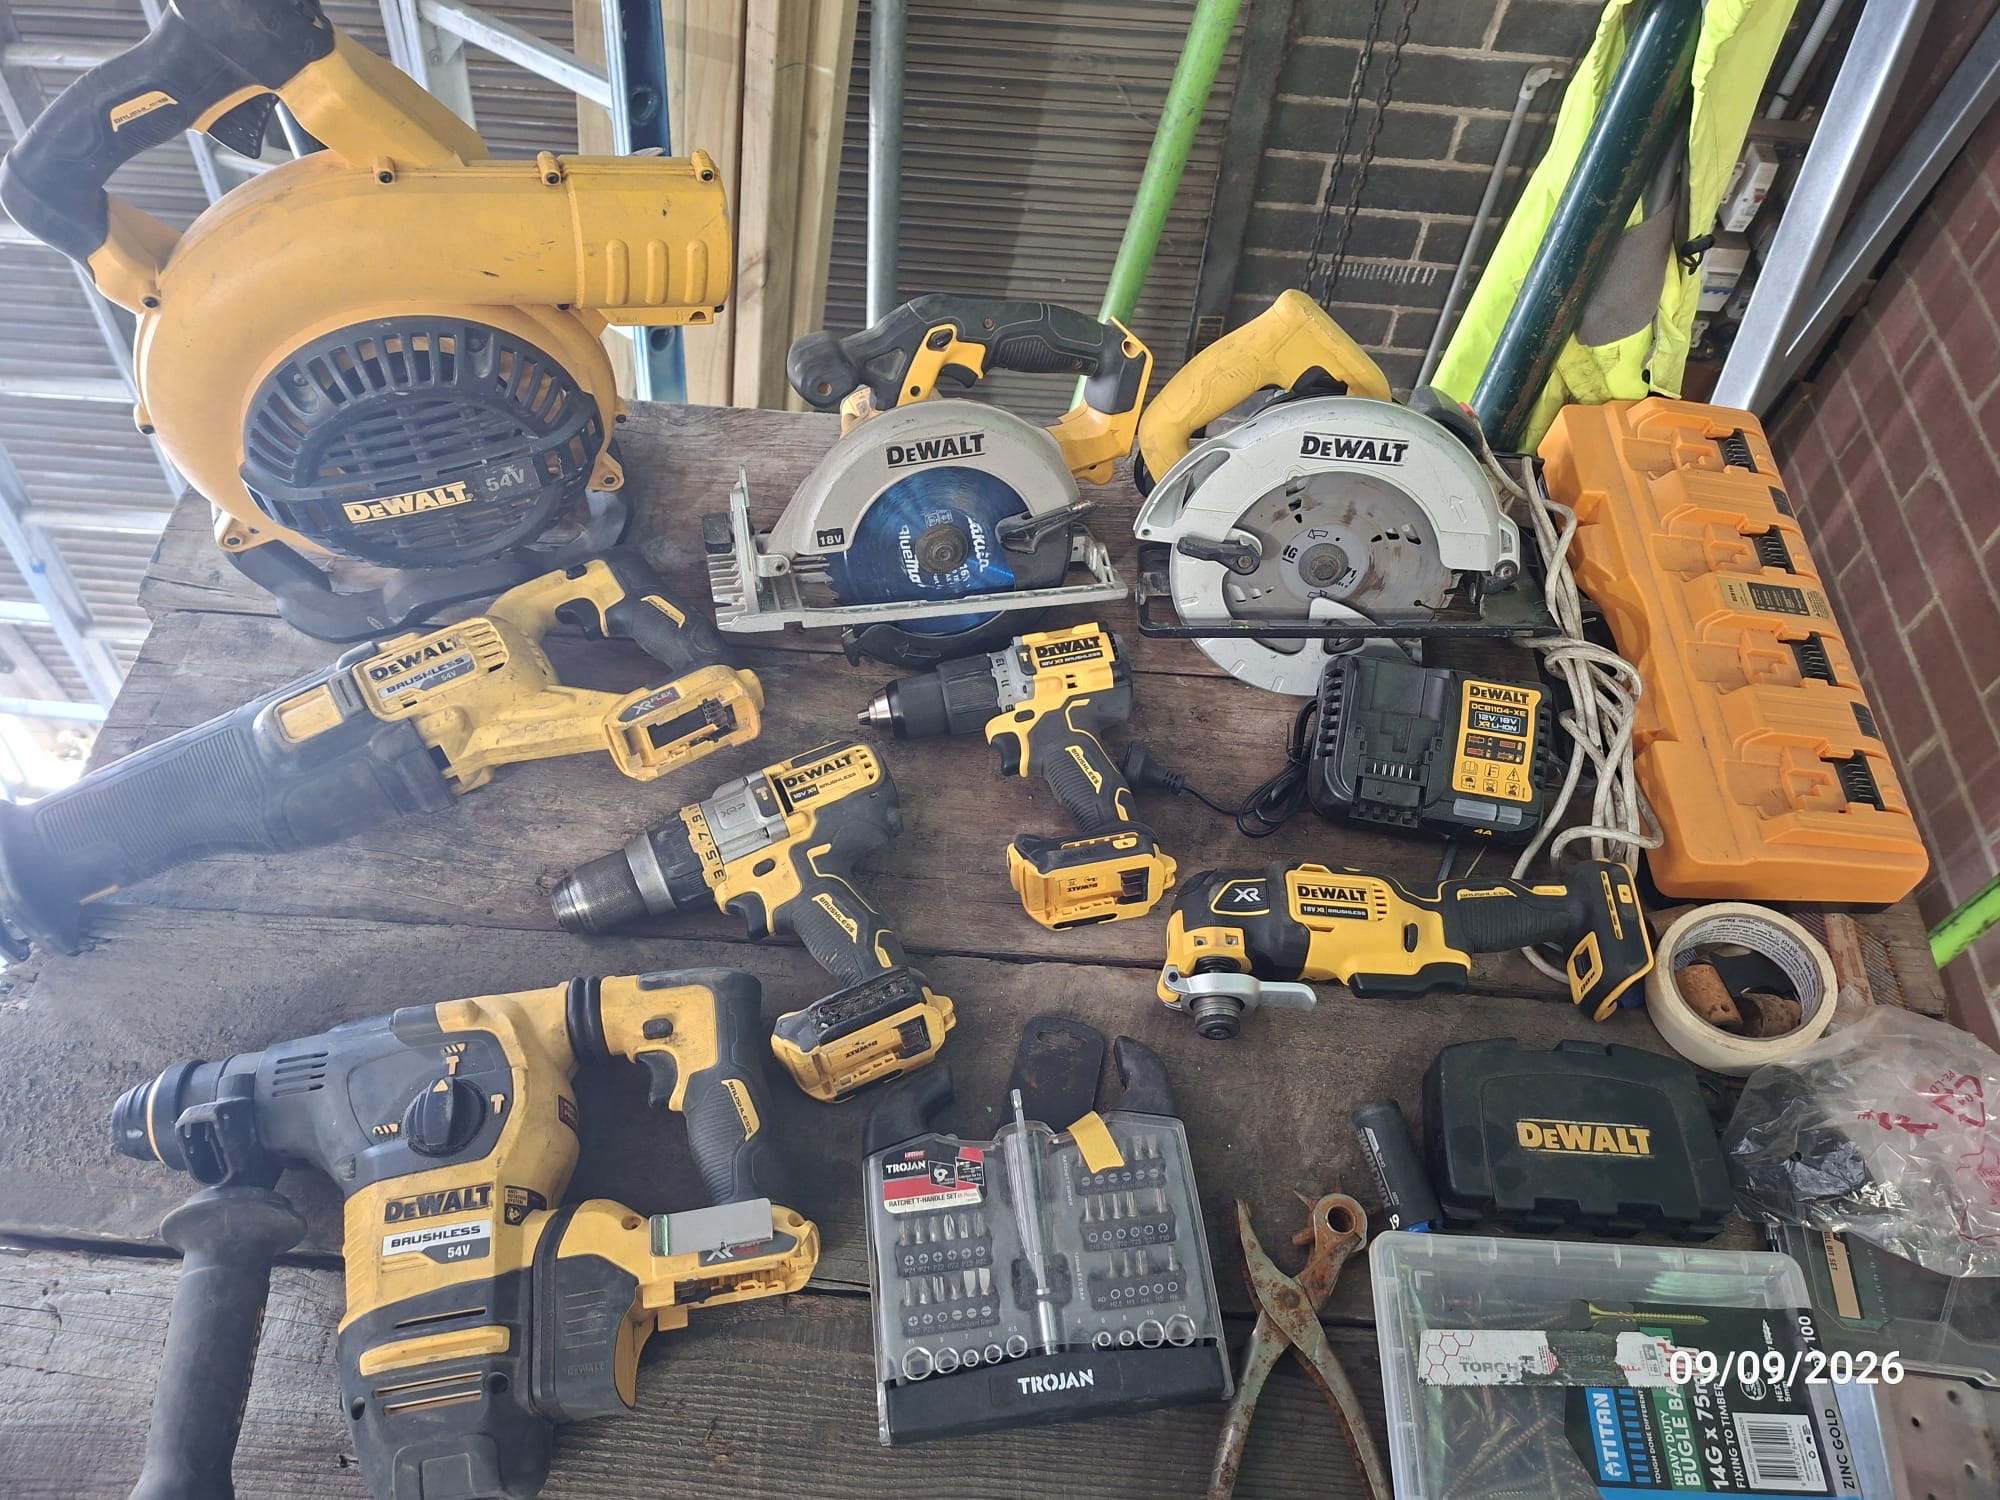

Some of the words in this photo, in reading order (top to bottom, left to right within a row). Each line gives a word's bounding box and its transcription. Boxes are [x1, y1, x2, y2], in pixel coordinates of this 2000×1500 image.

[485, 468, 525, 492] 54V
[818, 533, 842, 546] 18V
[386, 657, 465, 693] BRUSHLESS
[1471, 702, 1528, 717] DCB1104-XE
[1473, 828, 1494, 837] 4A
[1233, 887, 1261, 903] XR
[818, 895, 856, 935] BRUSHLESS
[728, 1081, 754, 1134] BRUSHLESS
[886, 1160, 926, 1174] TROJAN
[889, 1198, 915, 1208] RATCHET
[916, 1194, 946, 1204] T-HANDLE
[946, 1192, 957, 1200] SET
[390, 1225, 481, 1248] BRUSHLESS
[447, 1244, 471, 1258] 54V
[1798, 1315, 1816, 1344] 100
[1017, 1368, 1095, 1395] TROJAN
[1773, 1382, 1784, 1402] HEX
[1713, 1382, 1731, 1427] TIMBER
[1592, 1393, 1619, 1462] TITAN
[1659, 1409, 1675, 1443] DUTY
[1723, 1429, 1736, 1446] TO
[1824, 1408, 1844, 1451] GOLD
[1646, 1430, 1657, 1455] DONE
[1671, 1416, 1701, 1486] BUGLE
[1651, 1459, 1662, 1485] TOUGH
[1667, 1446, 1685, 1486] HEAVY
[1704, 1446, 1729, 1490] 14G
[1728, 1449, 1747, 1489] FIXING
[1836, 1454, 1855, 1490] ZINC
